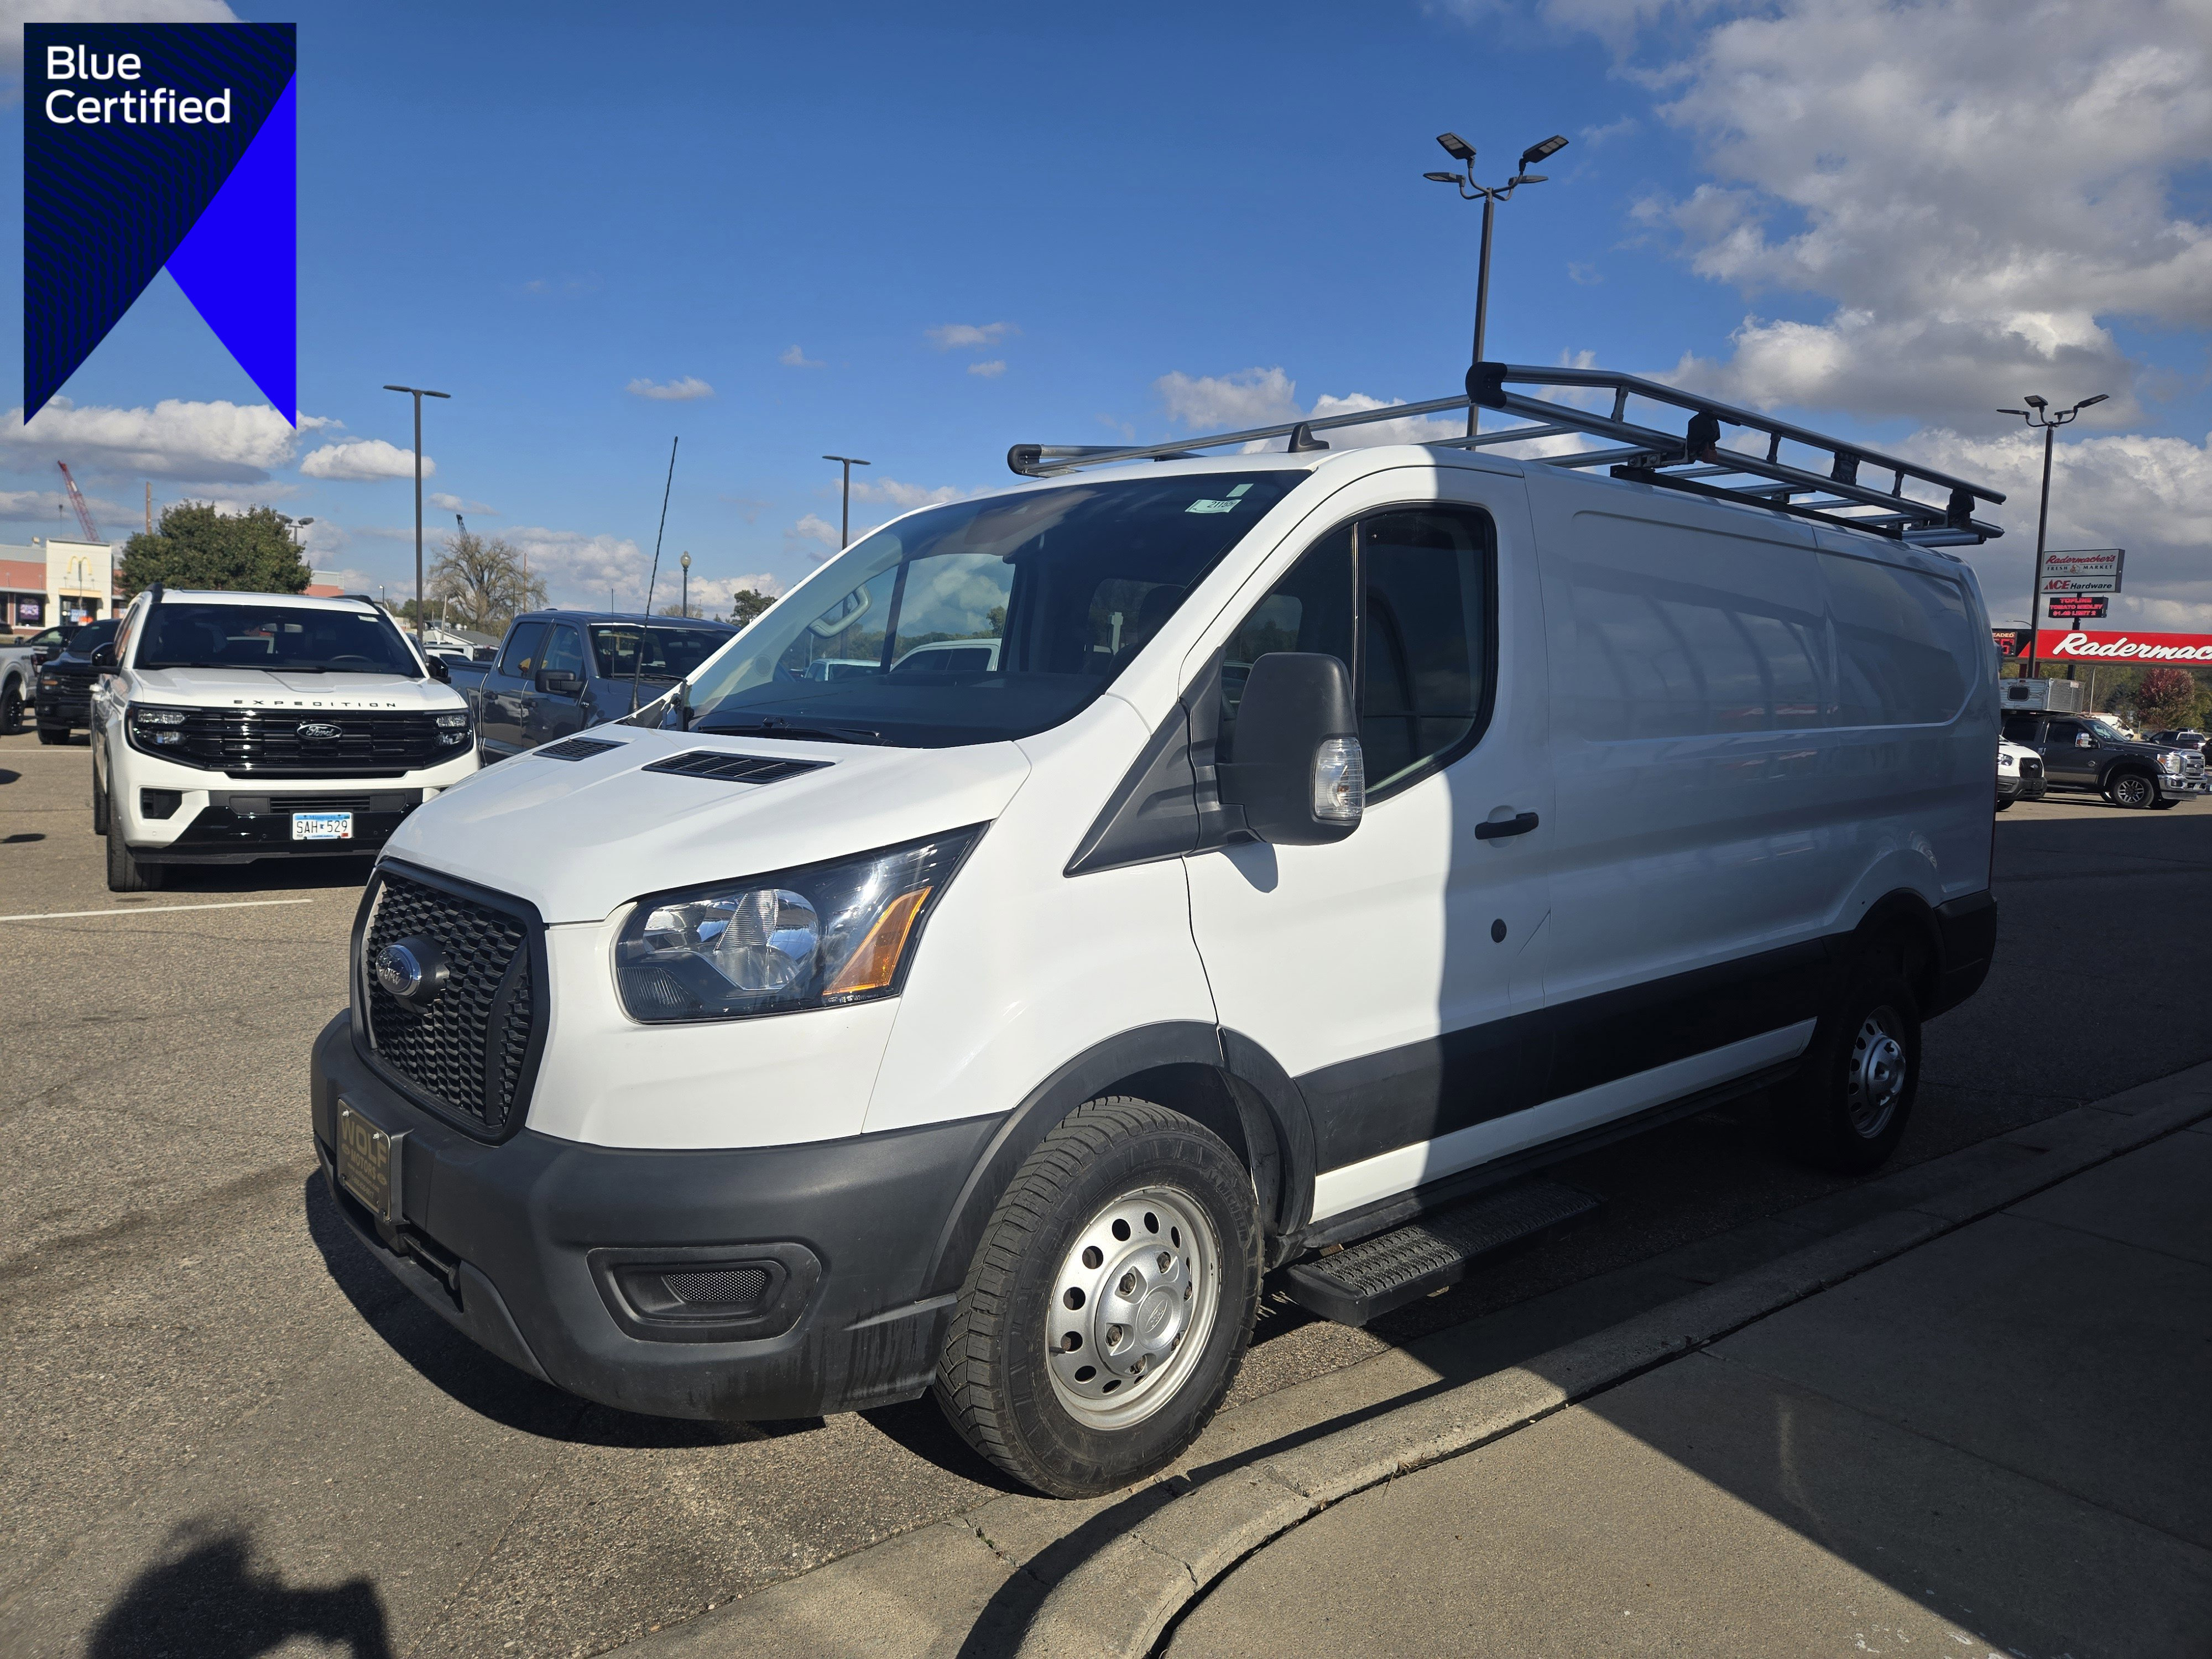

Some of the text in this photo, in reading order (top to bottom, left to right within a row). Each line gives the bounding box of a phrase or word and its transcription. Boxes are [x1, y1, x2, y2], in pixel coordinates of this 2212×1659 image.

[2046, 555, 2116, 564] Radermacher's
[2044, 579, 2071, 590] ACE
[306, 726, 333, 737] Ford
[296, 820, 347, 833] SAH 529
[341, 1114, 387, 1168] WOLF
[351, 1149, 376, 1180] MOTORS
